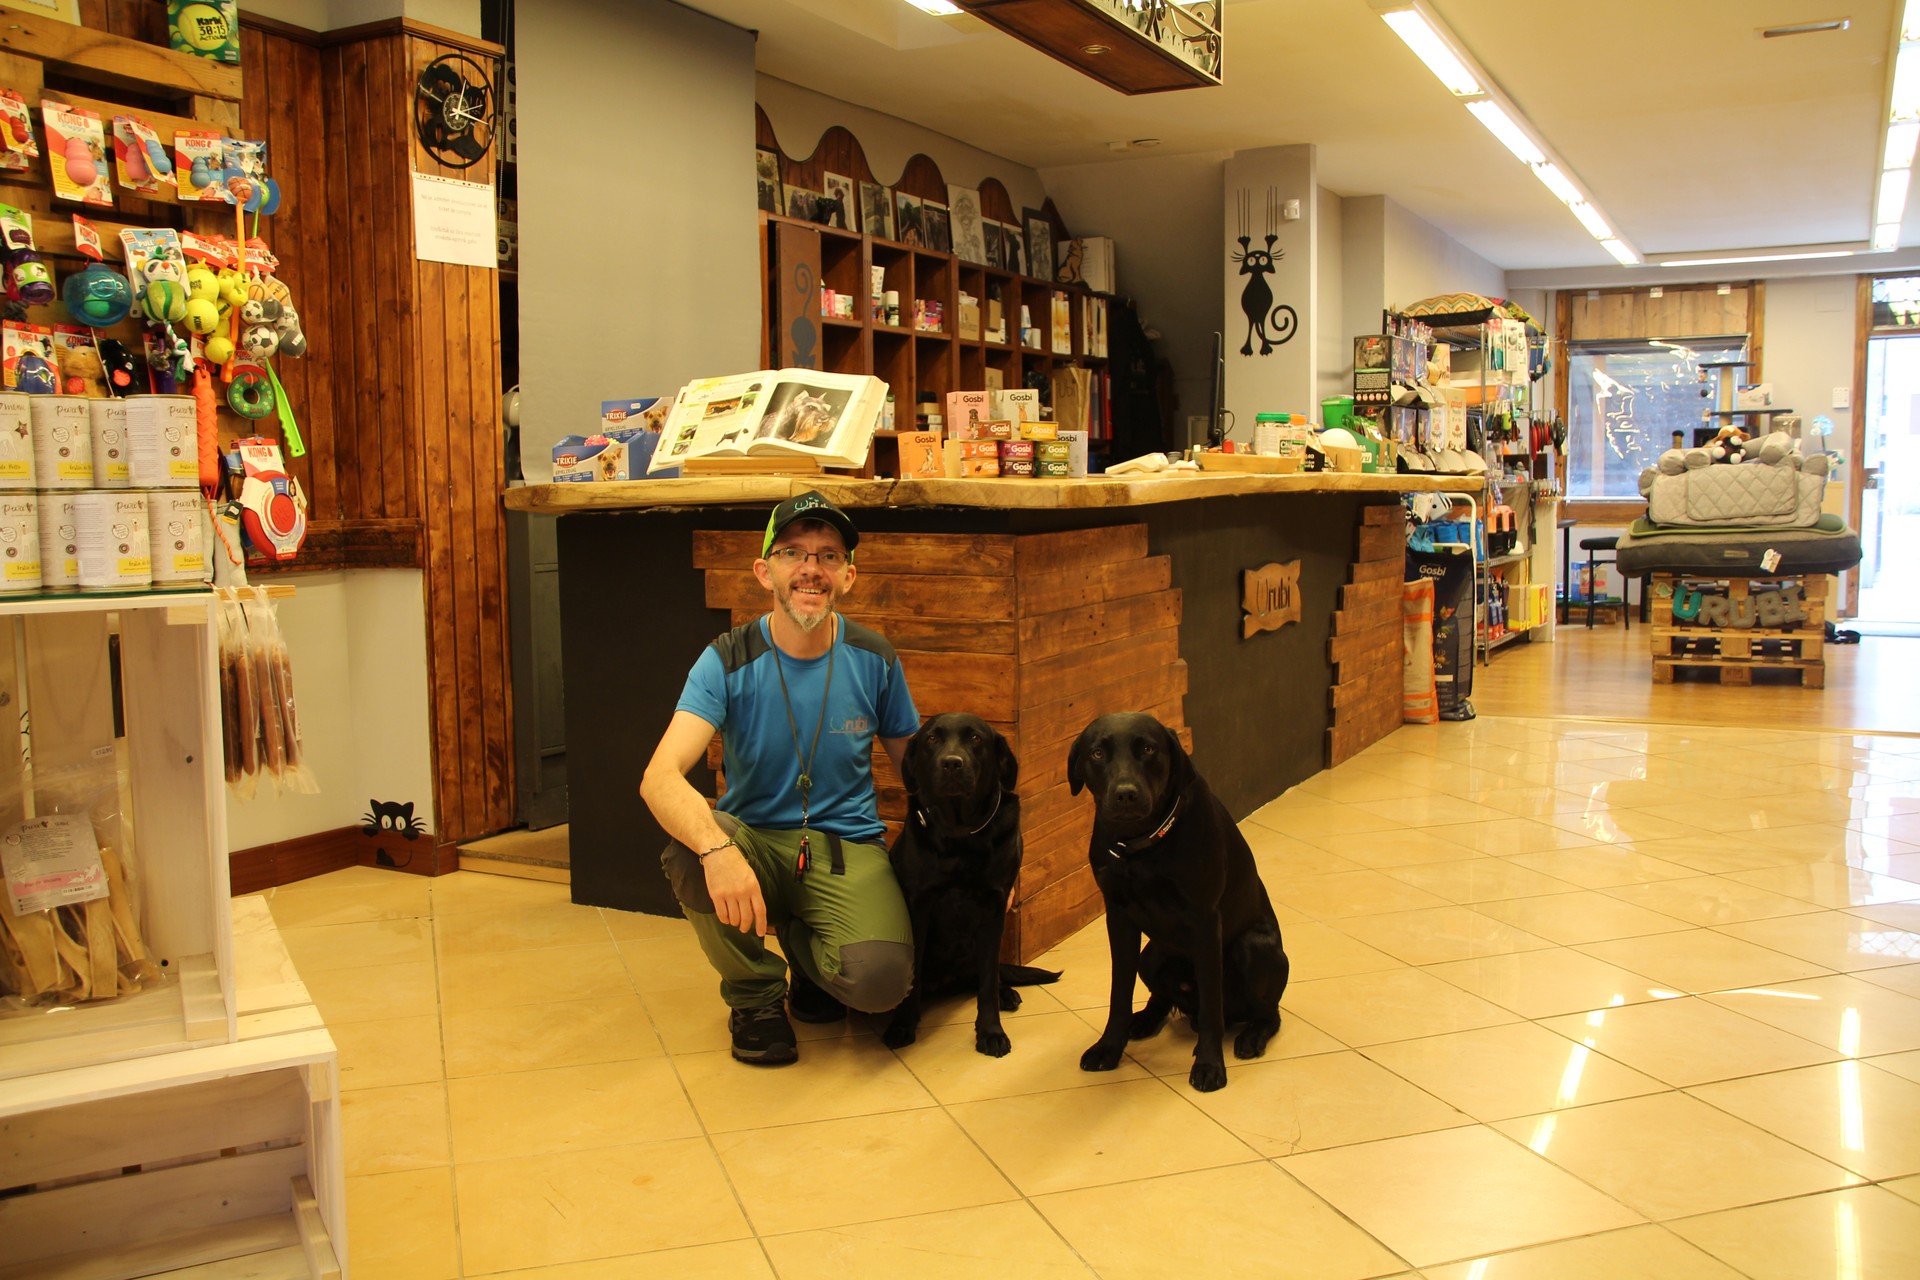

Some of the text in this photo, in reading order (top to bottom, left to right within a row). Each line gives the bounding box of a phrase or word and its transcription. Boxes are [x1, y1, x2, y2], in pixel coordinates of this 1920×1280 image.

[57, 112, 83, 127] KONG
[185, 139, 206, 147] KONG
[963, 395, 984, 403] Gosbi
[606, 411, 627, 420] TRIXIE
[991, 425, 1010, 433] Gosbi
[1032, 426, 1053, 434] Gosbi
[248, 447, 268, 458] KONG
[1011, 444, 1032, 453] Gosbi
[556, 456, 578, 465] TRIXIE
[1013, 463, 1032, 471] Gosbi
[1419, 564, 1447, 577] Gosbi
[1256, 576, 1291, 615] Urubi
[1672, 584, 1809, 629] URUBI
